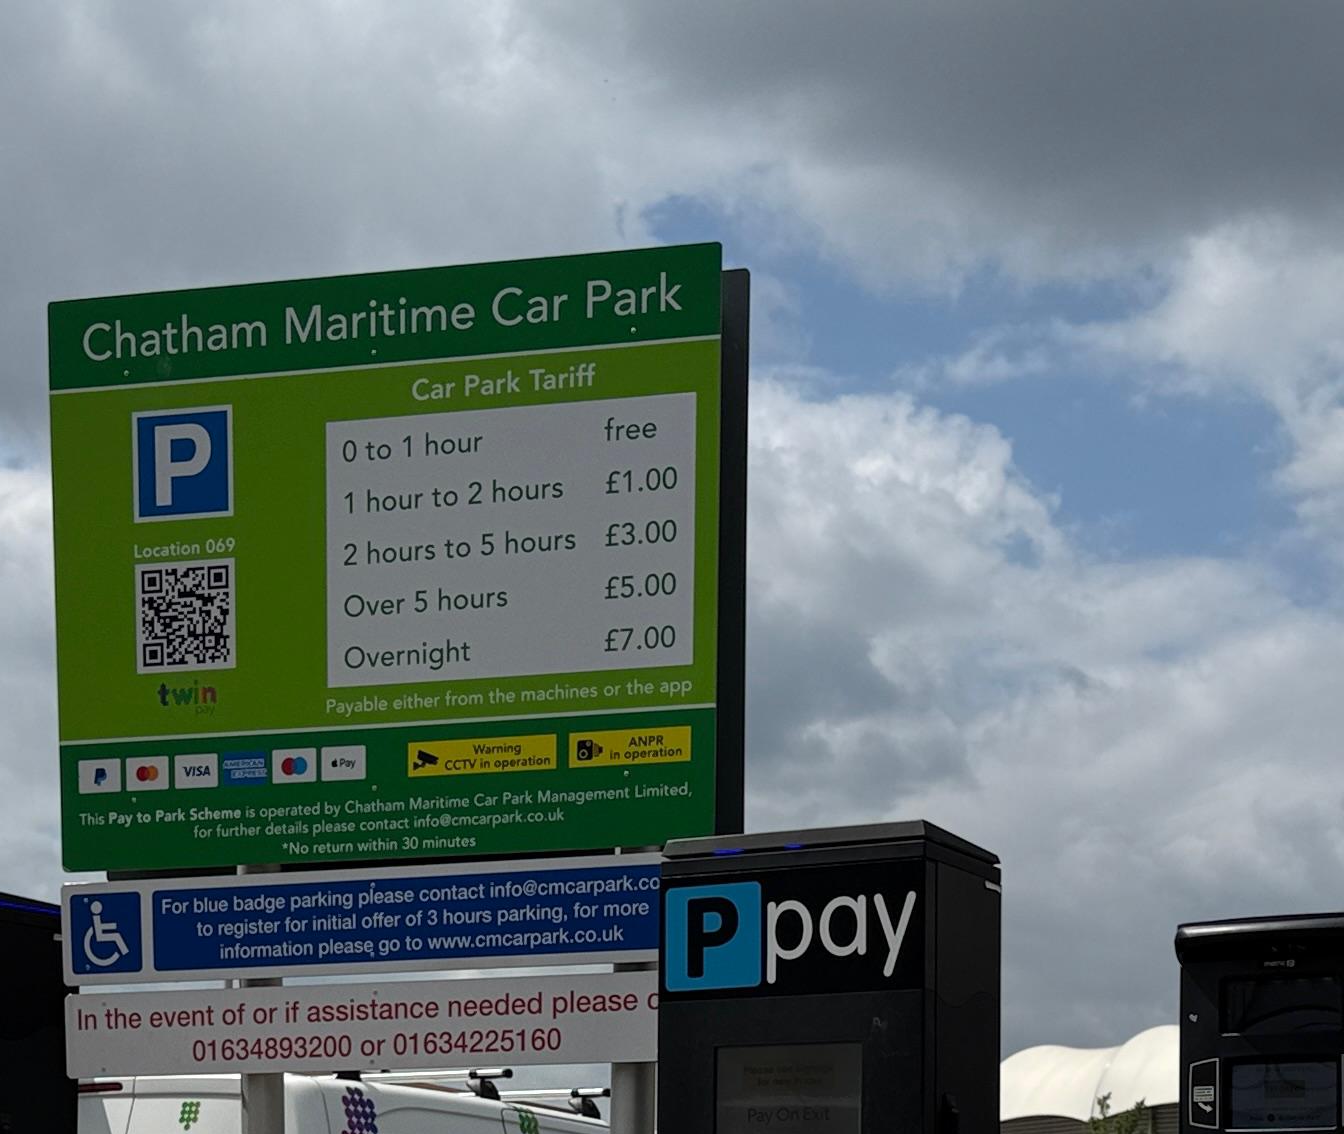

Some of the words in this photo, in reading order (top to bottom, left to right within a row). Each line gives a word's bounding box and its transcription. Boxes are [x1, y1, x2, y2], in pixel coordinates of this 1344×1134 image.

[83, 313, 267, 361] Chatham
[285, 296, 475, 344] Maritime
[492, 286, 568, 326] Car
[586, 271, 682, 318] Park
[411, 377, 456, 401] Car
[464, 370, 520, 397] Park
[528, 362, 596, 391] Tariff
[604, 417, 657, 441] free
[342, 439, 357, 463] 0
[365, 441, 392, 461] to
[402, 435, 411, 457] 1
[425, 432, 483, 456] hour
[155, 422, 213, 508] P
[605, 466, 677, 494] £1.00
[344, 491, 353, 514] 1
[367, 488, 423, 513] hour
[431, 487, 458, 507] to
[468, 481, 482, 505] 2
[492, 480, 563, 503] hours
[134, 541, 200, 558] Location
[205, 537, 235, 554] 069
[343, 543, 357, 566] 2
[367, 540, 436, 564] hours
[444, 539, 471, 559] to
[480, 532, 495, 556] 5
[505, 530, 576, 554] hours
[605, 519, 677, 547] £3.00
[604, 572, 676, 599] £5.00
[343, 594, 405, 618] Over
[414, 590, 428, 613] 5
[438, 588, 508, 611] hours
[604, 624, 675, 652] £7.00
[344, 639, 471, 670] Overnight
[158, 680, 218, 706] twin
[326, 695, 388, 716] Payable
[392, 693, 440, 710] either
[444, 690, 483, 706] from
[488, 688, 516, 704] the
[520, 684, 598, 702] machines
[603, 684, 621, 696] or
[625, 680, 654, 695] the
[659, 680, 692, 698] app
[472, 743, 521, 756] Warning
[609, 750, 620, 760] in
[623, 746, 682, 761] operation
[628, 734, 664, 747] ANPR
[182, 765, 211, 777] VISA
[339, 757, 356, 769] Pay
[444, 758, 477, 771] CCTV
[479, 757, 490, 768] in
[493, 755, 551, 770] operation
[79, 812, 105, 825] This
[108, 811, 133, 826] Pay
[135, 811, 151, 823] to
[155, 807, 186, 822] Park
[189, 806, 241, 821] Scheme
[245, 806, 256, 818] is
[259, 801, 320, 819] operated
[324, 801, 341, 816] by
[344, 798, 405, 814] Chatham
[409, 796, 470, 810] Maritime
[473, 793, 498, 807] Car
[502, 790, 533, 805] Park
[537, 787, 629, 804] Management
[634, 782, 692, 798] Limited,
[193, 824, 213, 838] for
[216, 822, 261, 837] further
[264, 819, 309, 835] details
[312, 819, 356, 836] please
[359, 817, 410, 831] contact
[413, 807, 564, 828] info@cmcarpark.co.uk
[312, 842, 353, 854] return
[356, 837, 398, 852] within
[402, 836, 419, 850] 30
[422, 836, 476, 849] minutes
[161, 898, 189, 914] For
[193, 896, 228, 913] blue
[233, 894, 285, 913] badge
[290, 890, 353, 912] parking
[358, 888, 414, 908] please
[418, 883, 485, 902] contact
[196, 921, 213, 936] to
[218, 918, 281, 939] register
[284, 916, 308, 932] for
[312, 913, 356, 931] initial
[361, 912, 401, 929] offer
[405, 910, 423, 927] of
[427, 909, 438, 925] 3
[442, 909, 492, 924] hours
[497, 904, 568, 926] parking,
[573, 902, 599, 918] for
[603, 902, 649, 917] more
[220, 940, 313, 959] information
[318, 938, 374, 958] please
[378, 938, 400, 956] go
[405, 935, 423, 951] to
[427, 924, 624, 949] www.cmcarpark.co.uk
[687, 896, 739, 979] P
[766, 890, 917, 985] pay
[77, 1008, 97, 1030] In
[104, 1007, 142, 1030] the
[149, 1005, 214, 1028] event
[222, 1002, 245, 1026] of
[252, 1007, 278, 1024] or
[285, 1001, 299, 1023] if
[307, 999, 439, 1023] assistance
[448, 993, 542, 1017] needed
[552, 991, 638, 1019] please
[192, 1034, 352, 1062] 01634893200
[360, 1039, 386, 1056] or
[393, 1027, 561, 1055] 01634225160
[747, 1108, 773, 1125] Pay
[777, 1107, 799, 1121] On
[803, 1106, 831, 1120] Exit
